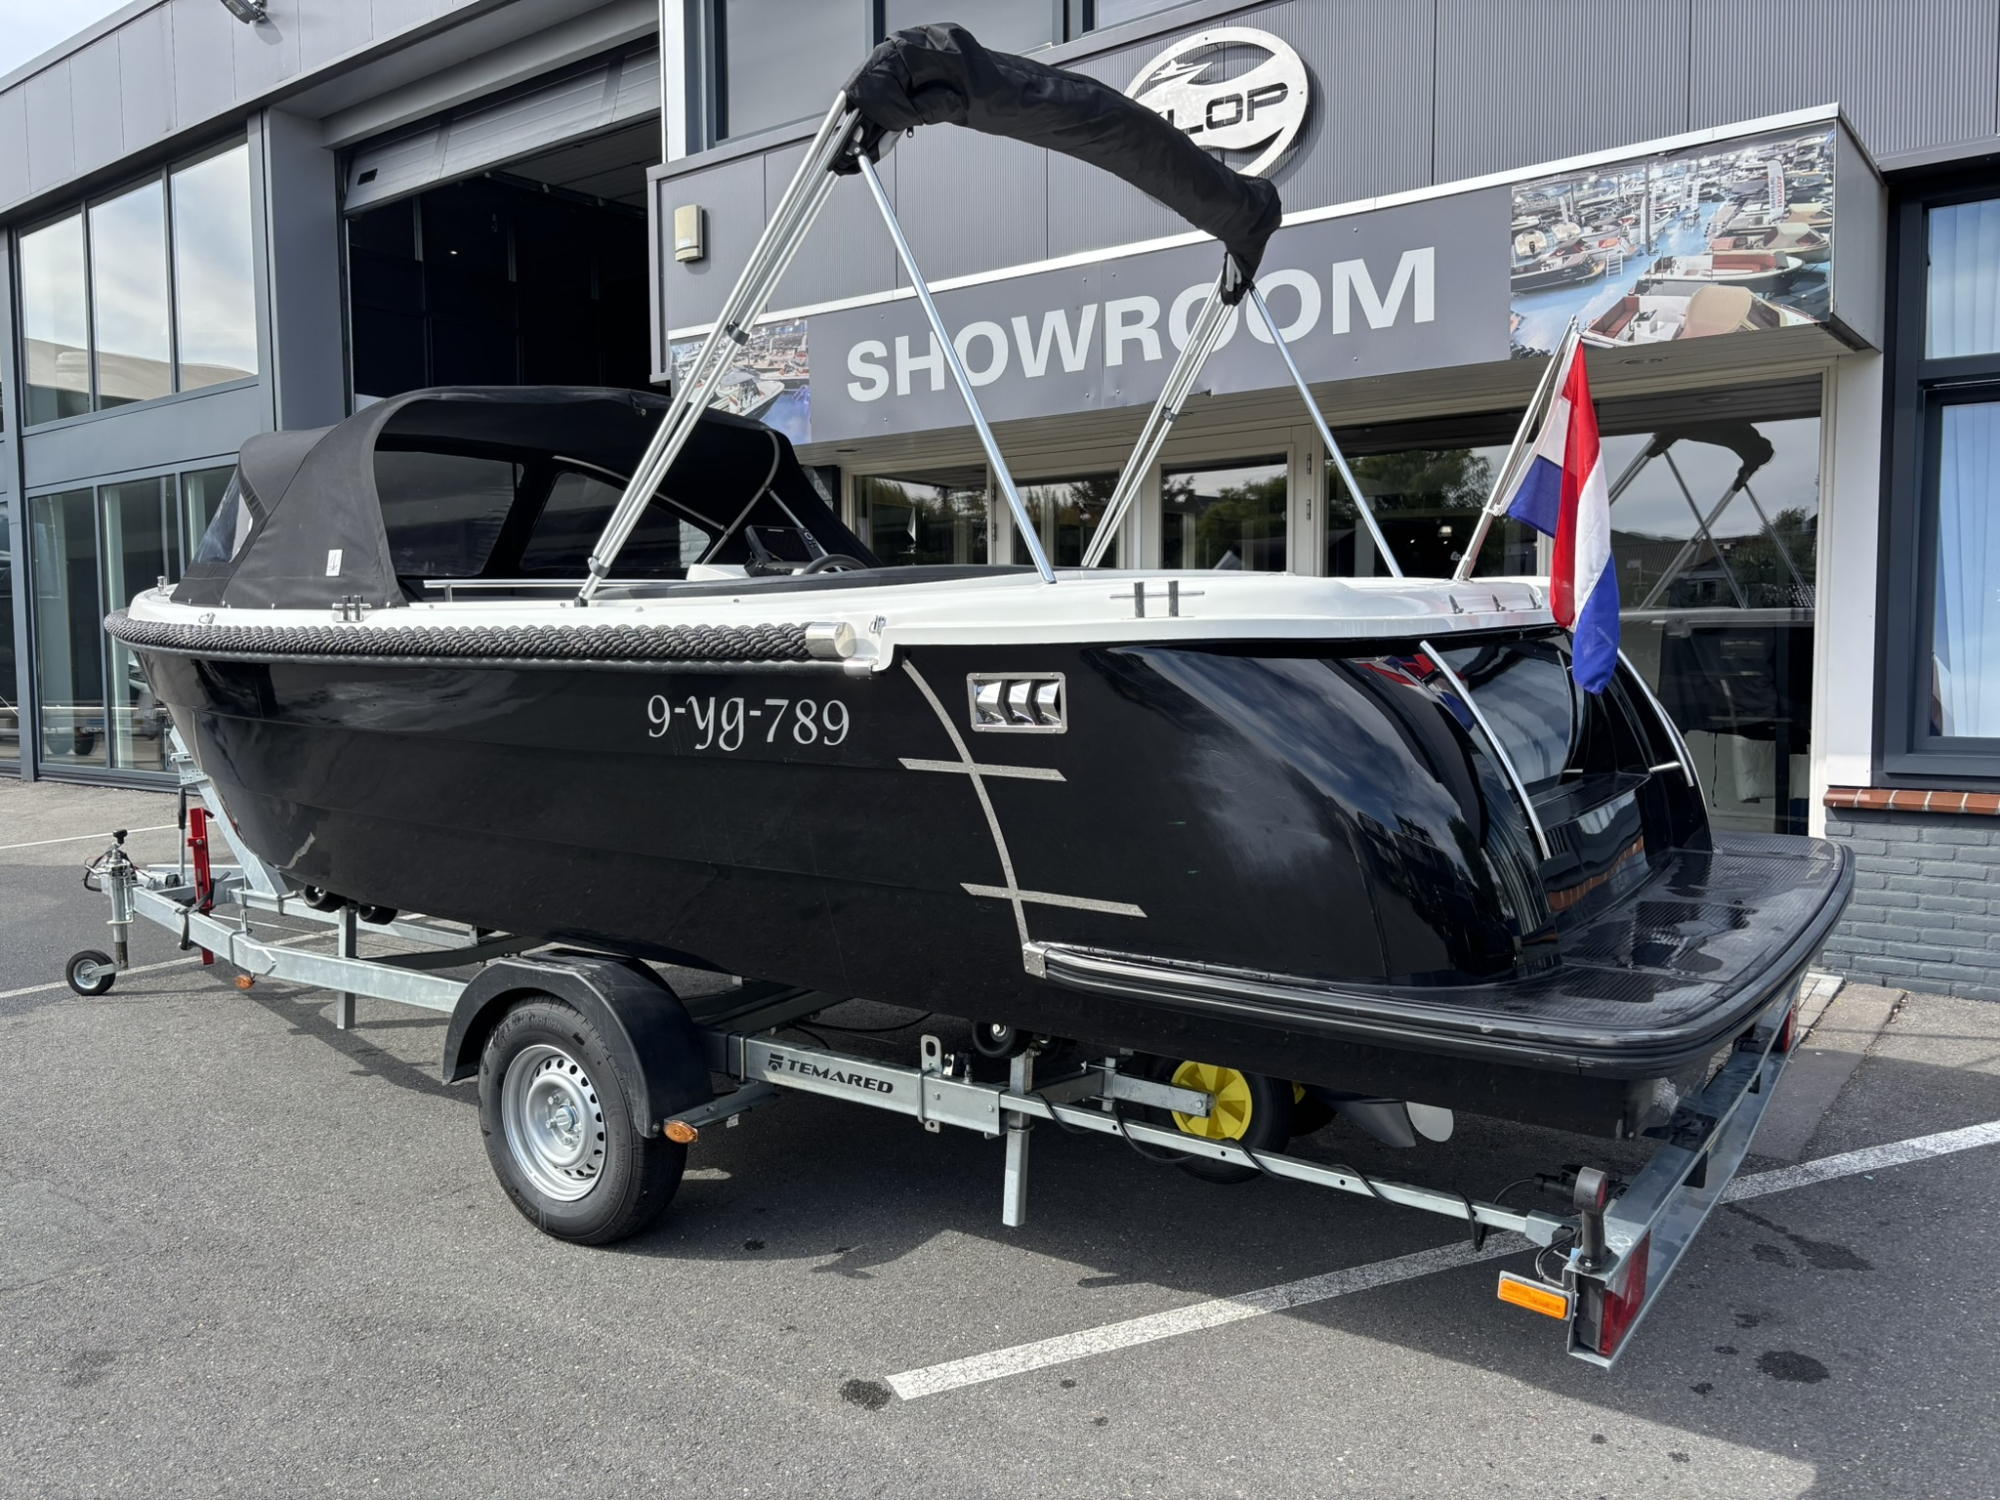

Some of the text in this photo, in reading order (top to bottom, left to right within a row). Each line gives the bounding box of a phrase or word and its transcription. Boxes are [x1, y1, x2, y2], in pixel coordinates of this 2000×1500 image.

[1158, 82, 1289, 136] LOP
[846, 246, 1435, 402] SHOWROOM
[787, 1058, 894, 1094] TEMARED
